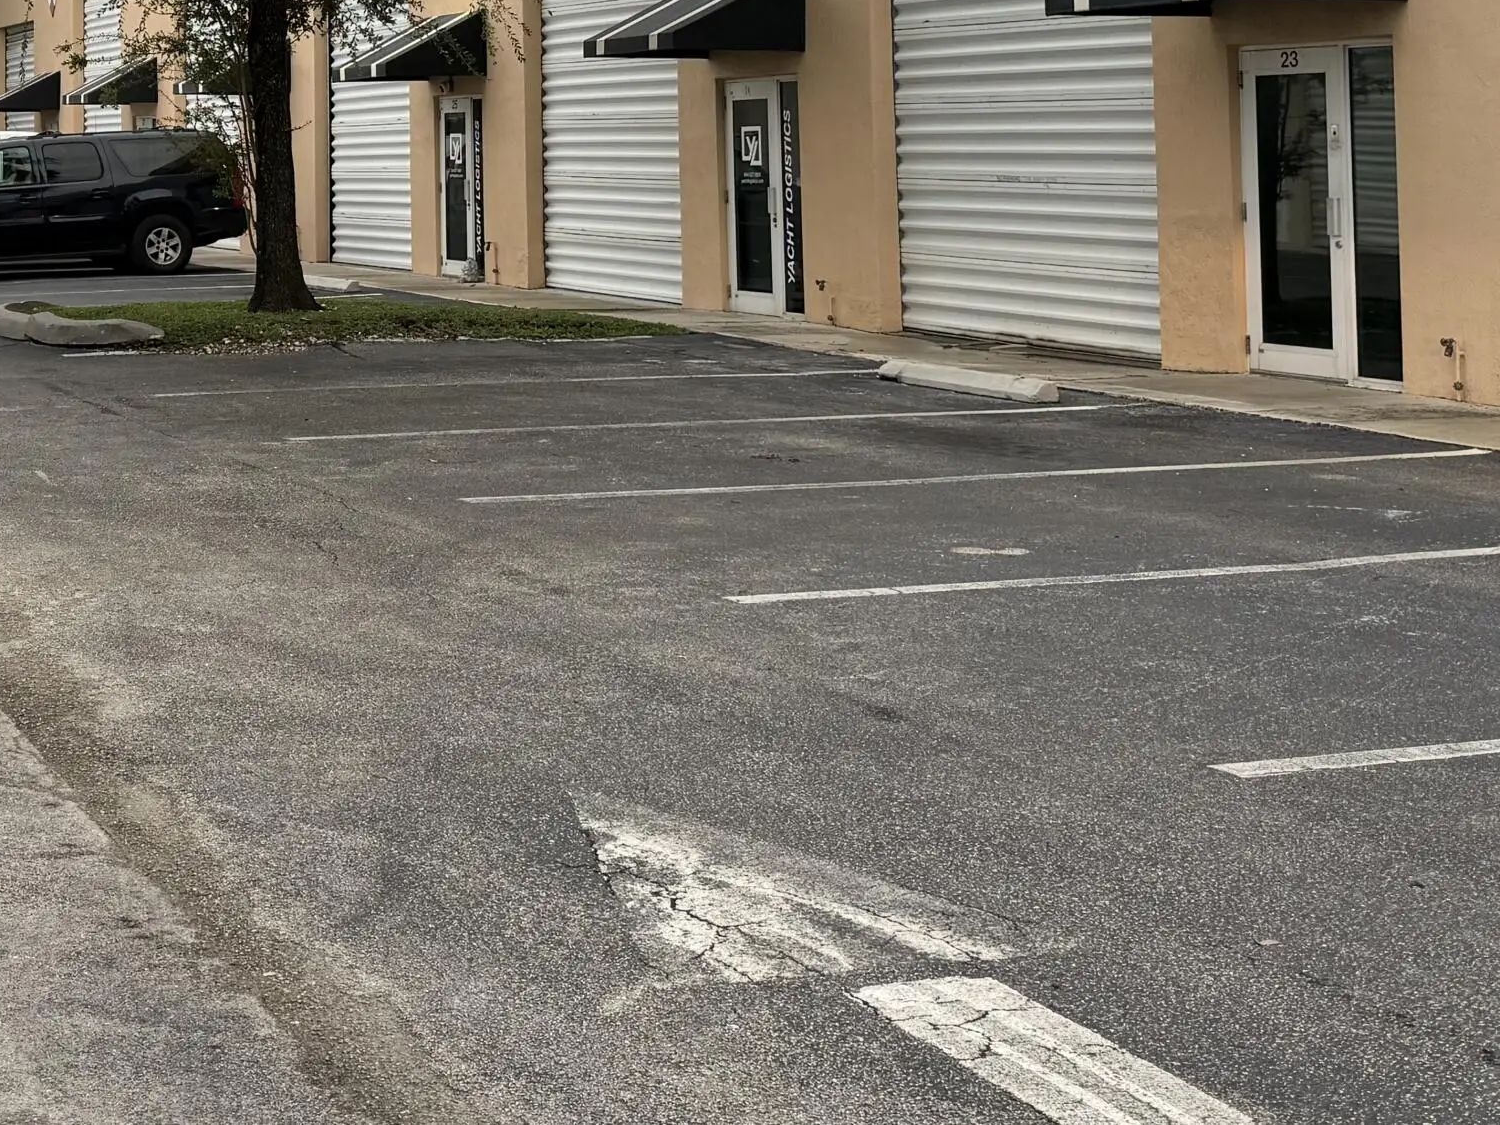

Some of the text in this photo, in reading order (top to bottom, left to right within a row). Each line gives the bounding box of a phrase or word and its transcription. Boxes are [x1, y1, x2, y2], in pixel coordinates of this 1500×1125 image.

[1280, 50, 1299, 68] 23
[783, 109, 796, 284] YACHT LOGISTICS
